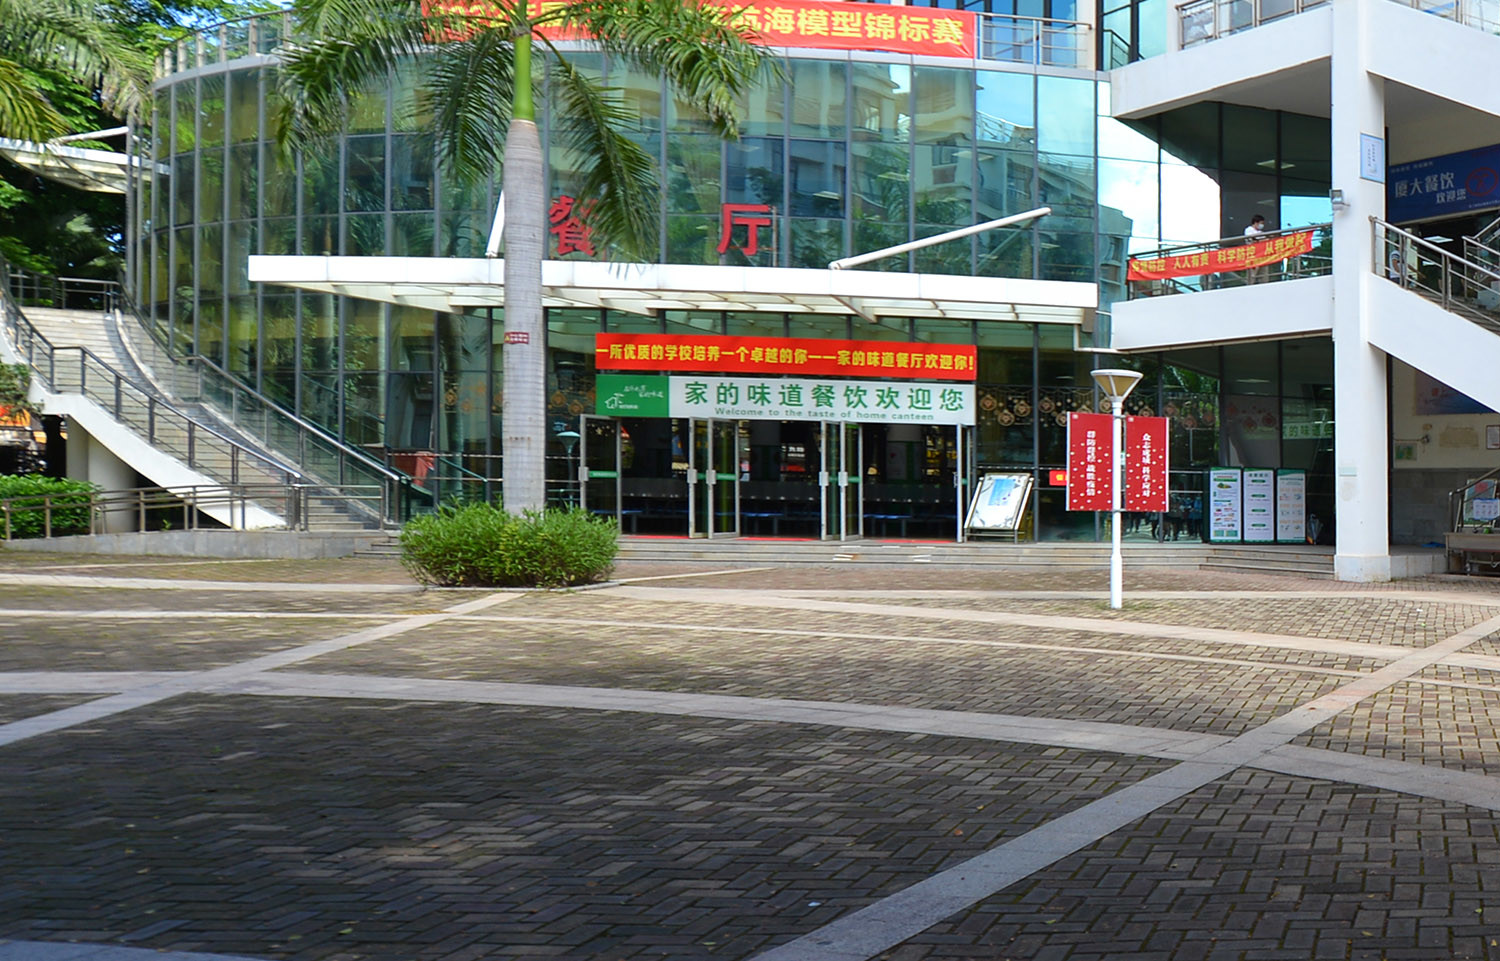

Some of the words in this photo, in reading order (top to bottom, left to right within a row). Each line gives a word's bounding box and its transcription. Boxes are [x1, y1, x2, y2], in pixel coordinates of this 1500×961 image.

[1394, 171, 1455, 199] 厦大餐饮
[1435, 189, 1467, 204] 欢迎您
[548, 194, 771, 257] 餐厅
[685, 381, 964, 412] 家的味道餐饮欢迎您
[715, 407, 763, 416] Welcome
[769, 408, 780, 417] to
[785, 409, 803, 417] the
[841, 411, 851, 419] of
[856, 411, 887, 419] home
